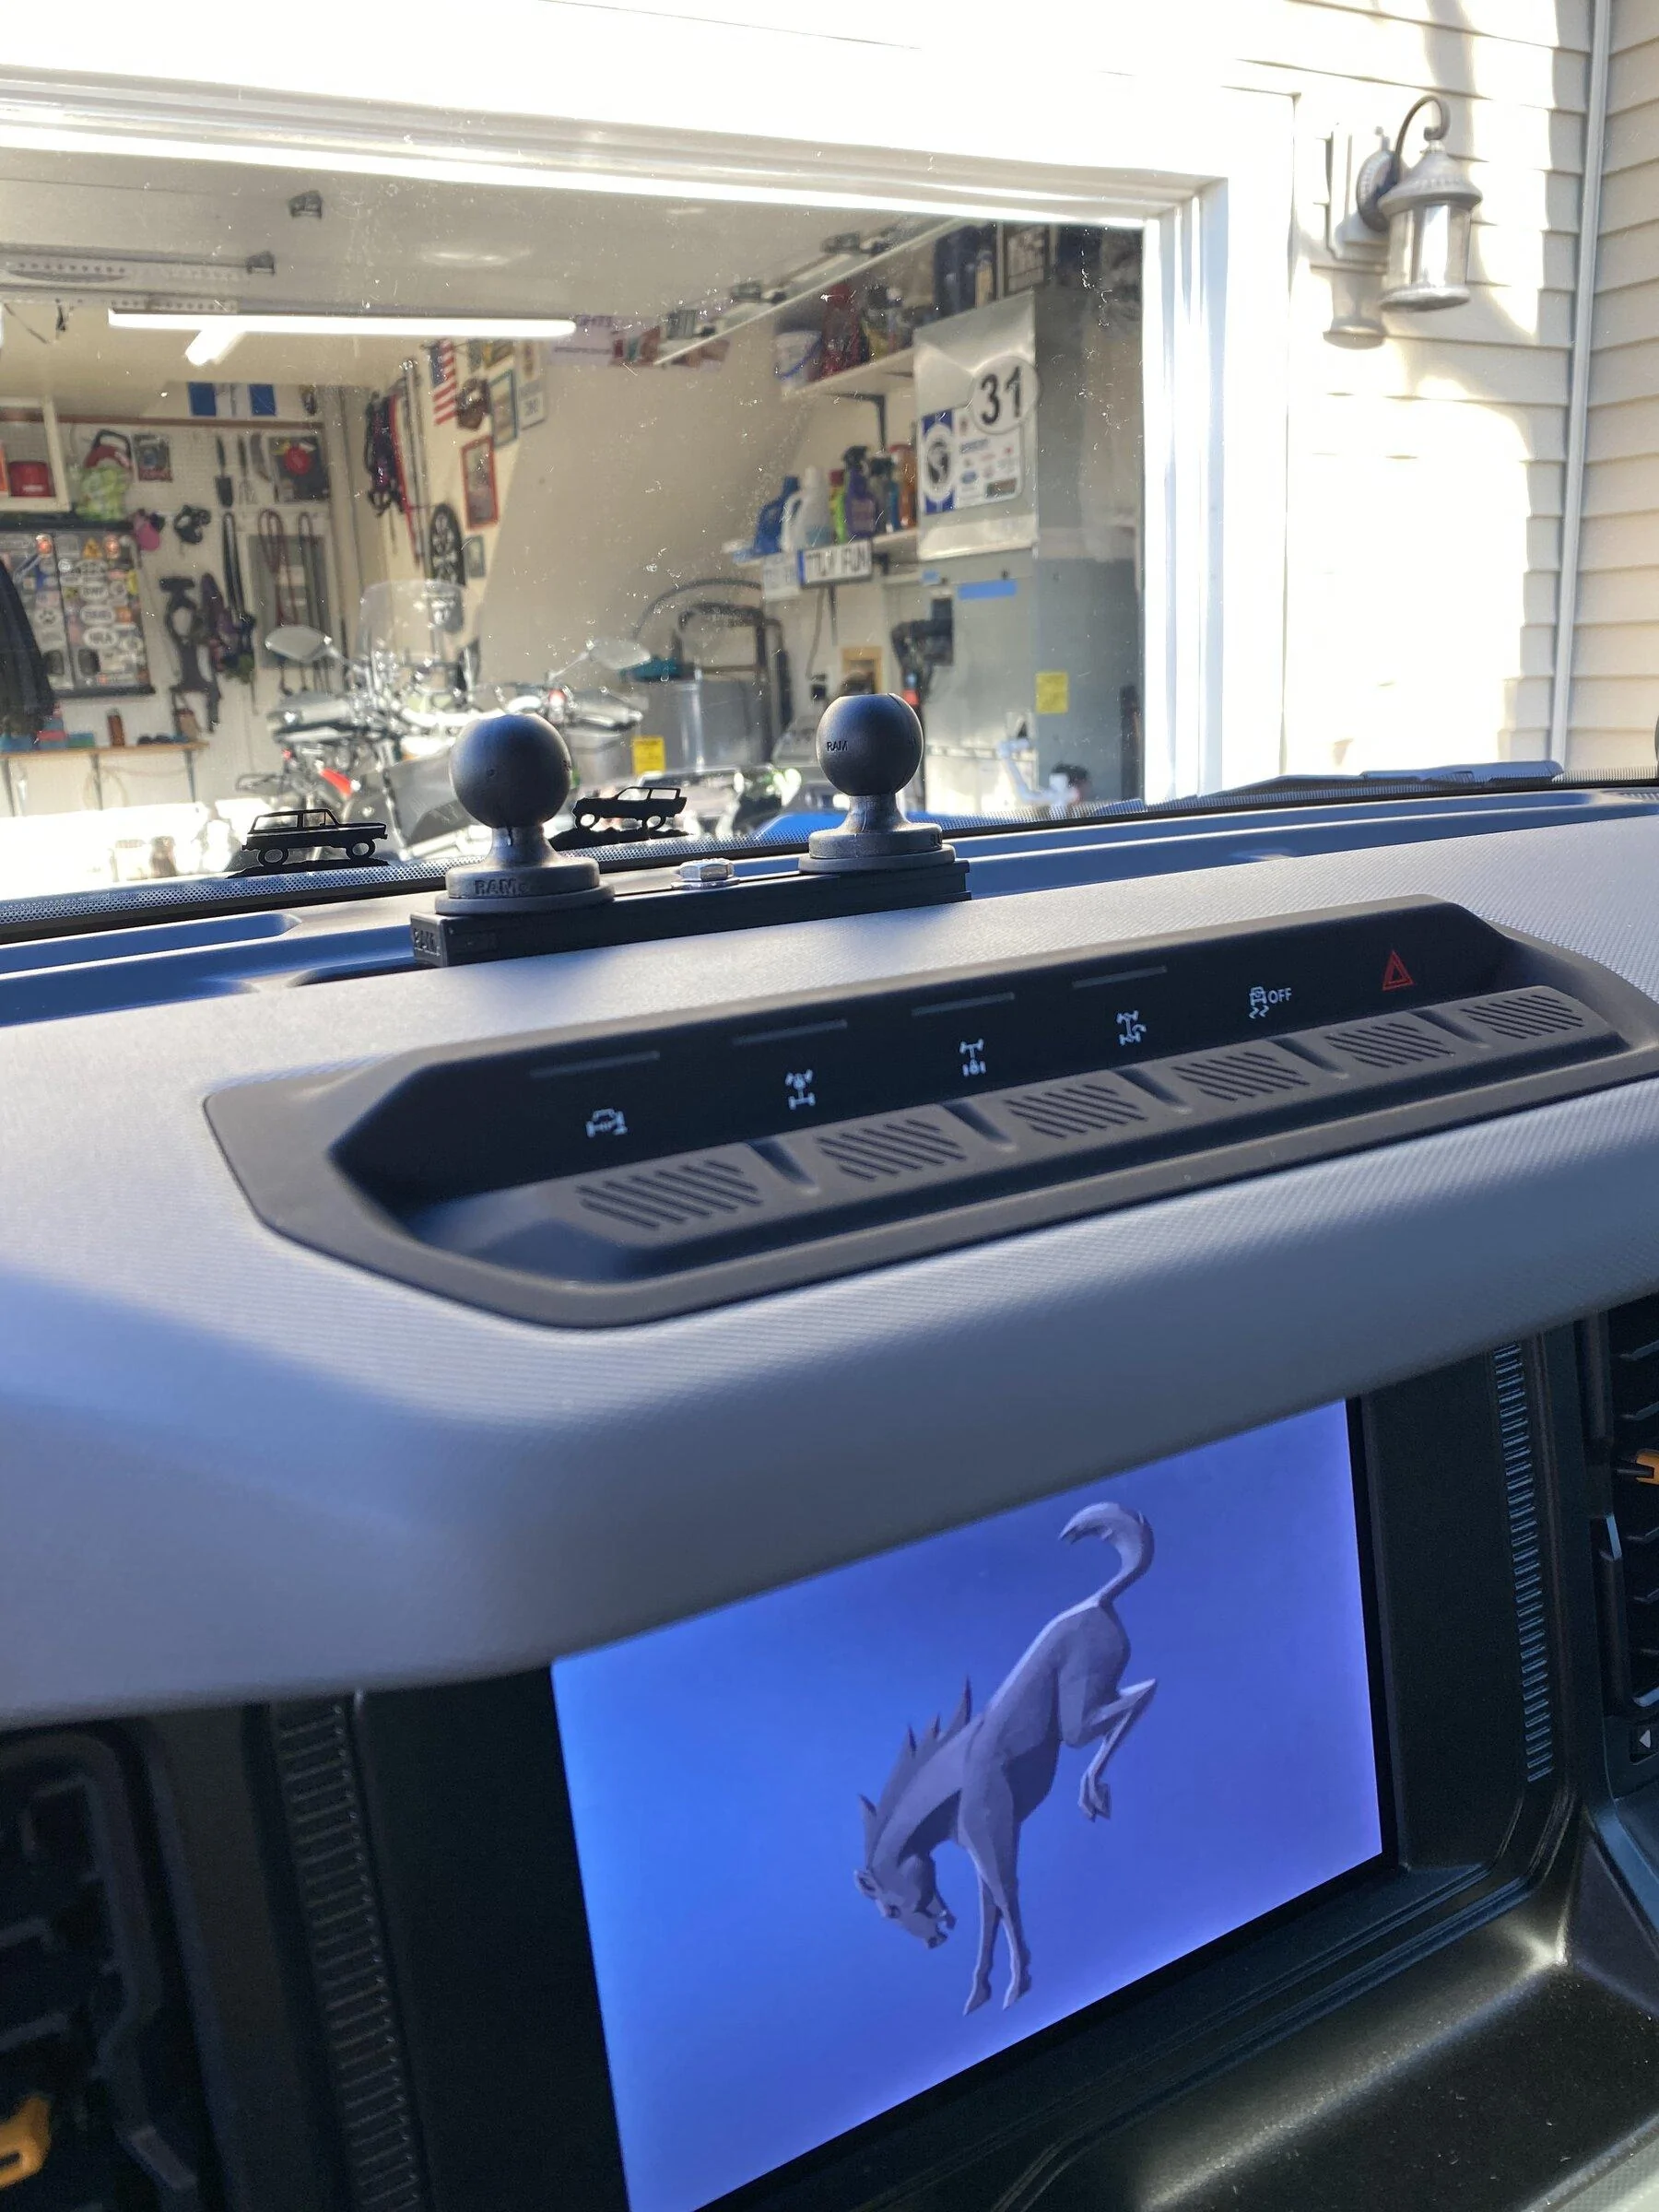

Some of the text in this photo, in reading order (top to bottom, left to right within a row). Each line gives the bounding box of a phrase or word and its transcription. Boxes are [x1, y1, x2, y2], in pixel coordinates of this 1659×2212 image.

[981, 366, 1021, 426] 31
[827, 740, 848, 752] RAM
[1267, 987, 1292, 1005] OFF
